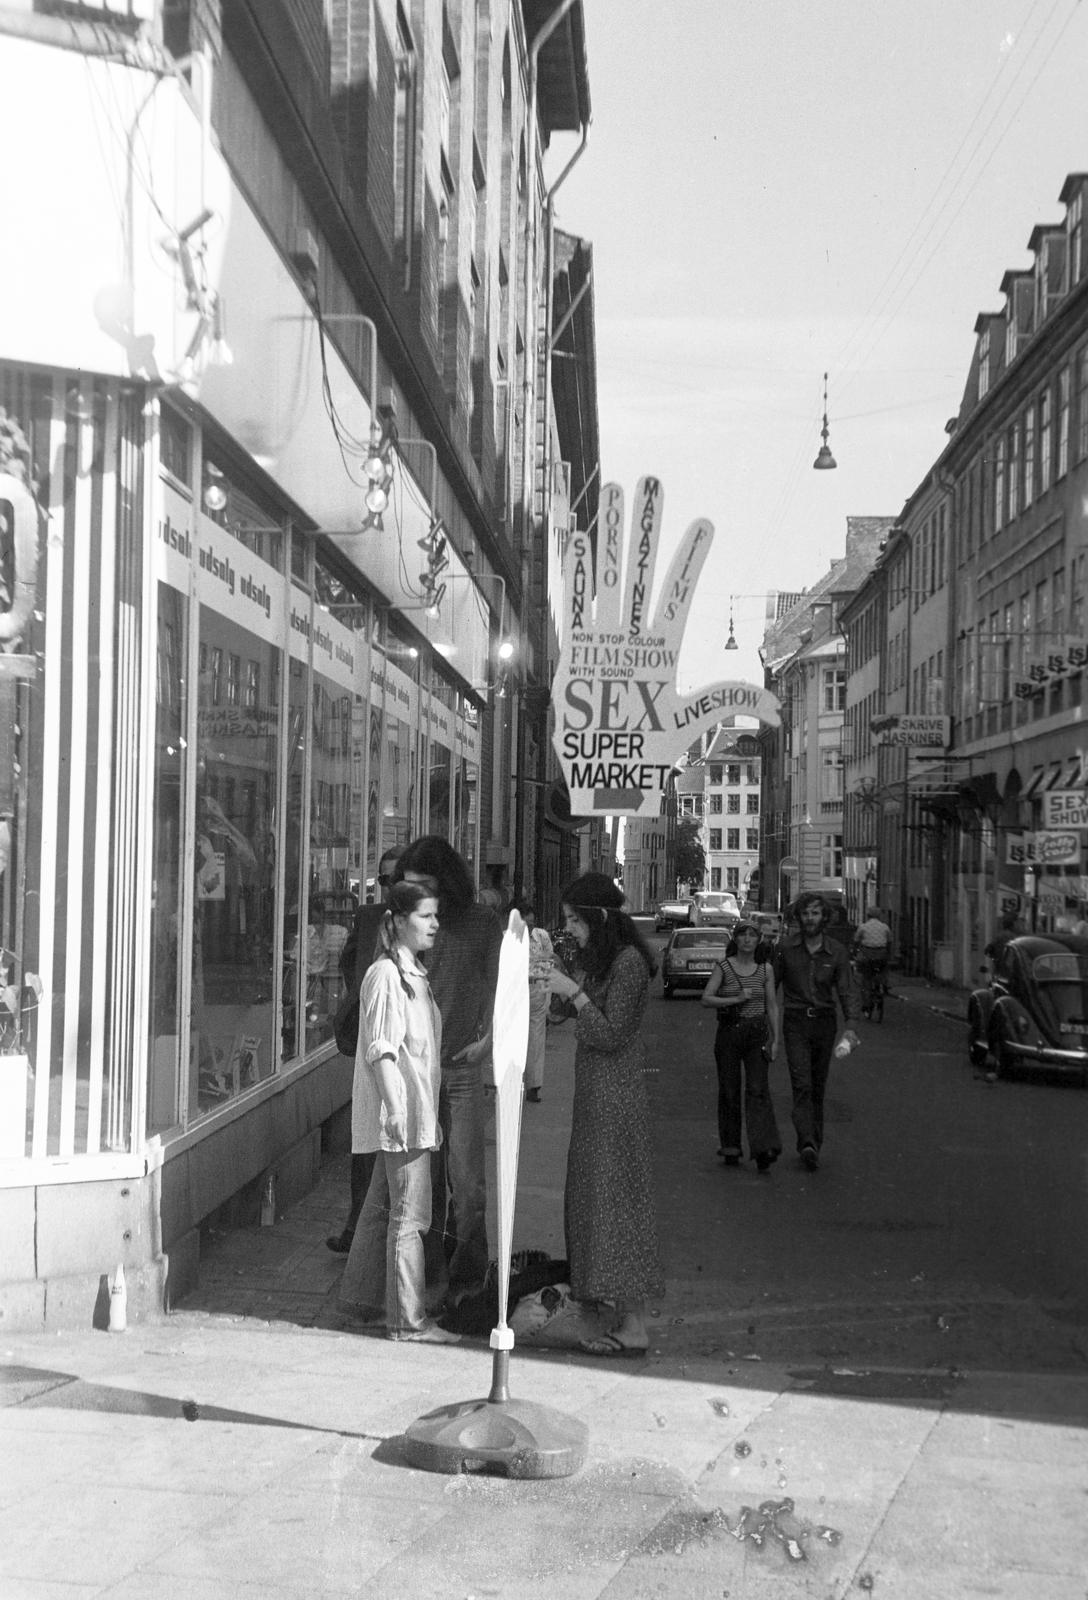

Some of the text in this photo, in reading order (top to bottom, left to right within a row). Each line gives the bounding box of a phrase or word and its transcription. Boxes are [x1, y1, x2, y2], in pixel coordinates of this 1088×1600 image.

[603, 489, 619, 588] PORNO
[630, 479, 660, 636] MAGAZINES
[199, 545, 236, 596] udsalg
[241, 574, 271, 620] udsalg
[571, 538, 586, 629] SAUNA
[664, 527, 706, 621] FILMS
[572, 633, 666, 648] NON STOP COLOUR
[569, 667, 635, 679] WITH SOUND
[563, 679, 668, 732] SEX
[882, 732, 944, 744] MASKINER
[902, 719, 944, 730] SKRIVE
[563, 733, 645, 760] SUPER
[571, 763, 670, 790] MARKET
[1050, 794, 1088, 812] SEX
